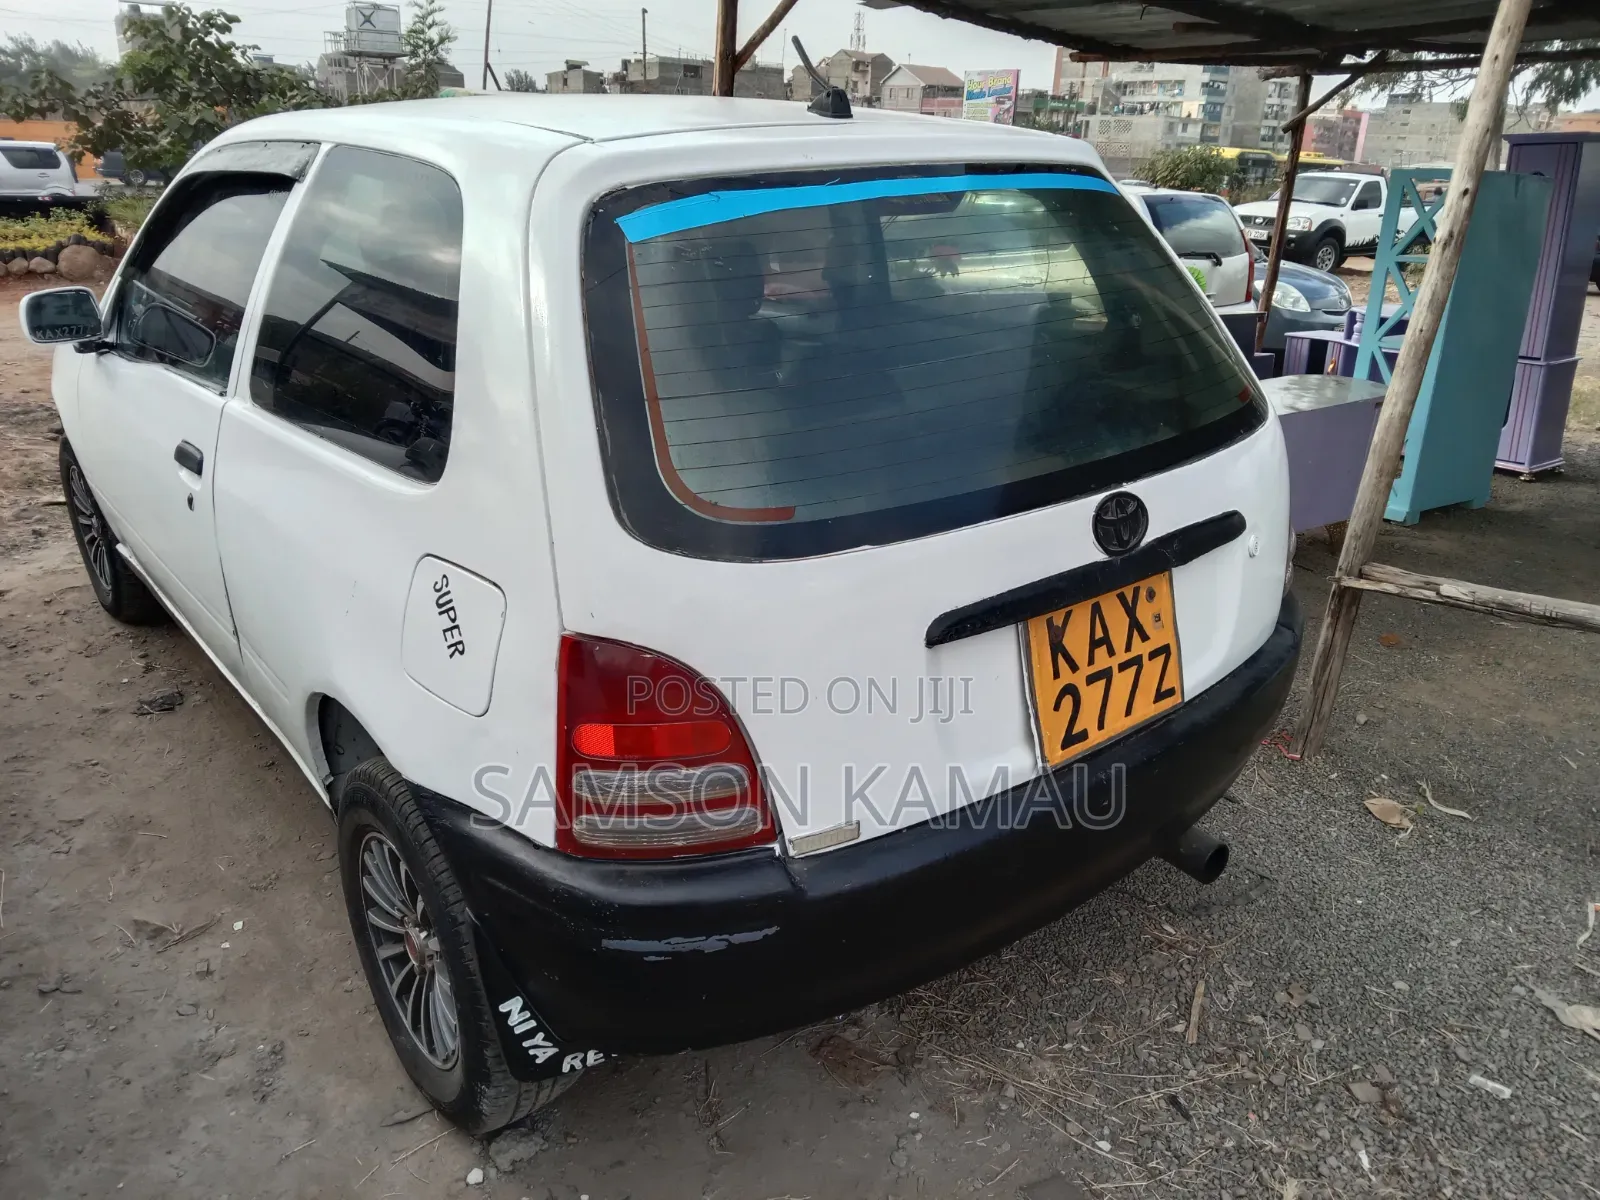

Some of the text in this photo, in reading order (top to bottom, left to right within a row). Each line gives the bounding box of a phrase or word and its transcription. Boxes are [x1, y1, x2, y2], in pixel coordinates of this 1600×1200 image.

[967, 79, 985, 91] Your
[988, 73, 1012, 87] Brand
[433, 574, 465, 660] SUPER
[1046, 586, 1150, 680] KAX
[1053, 643, 1176, 751] 277Z
